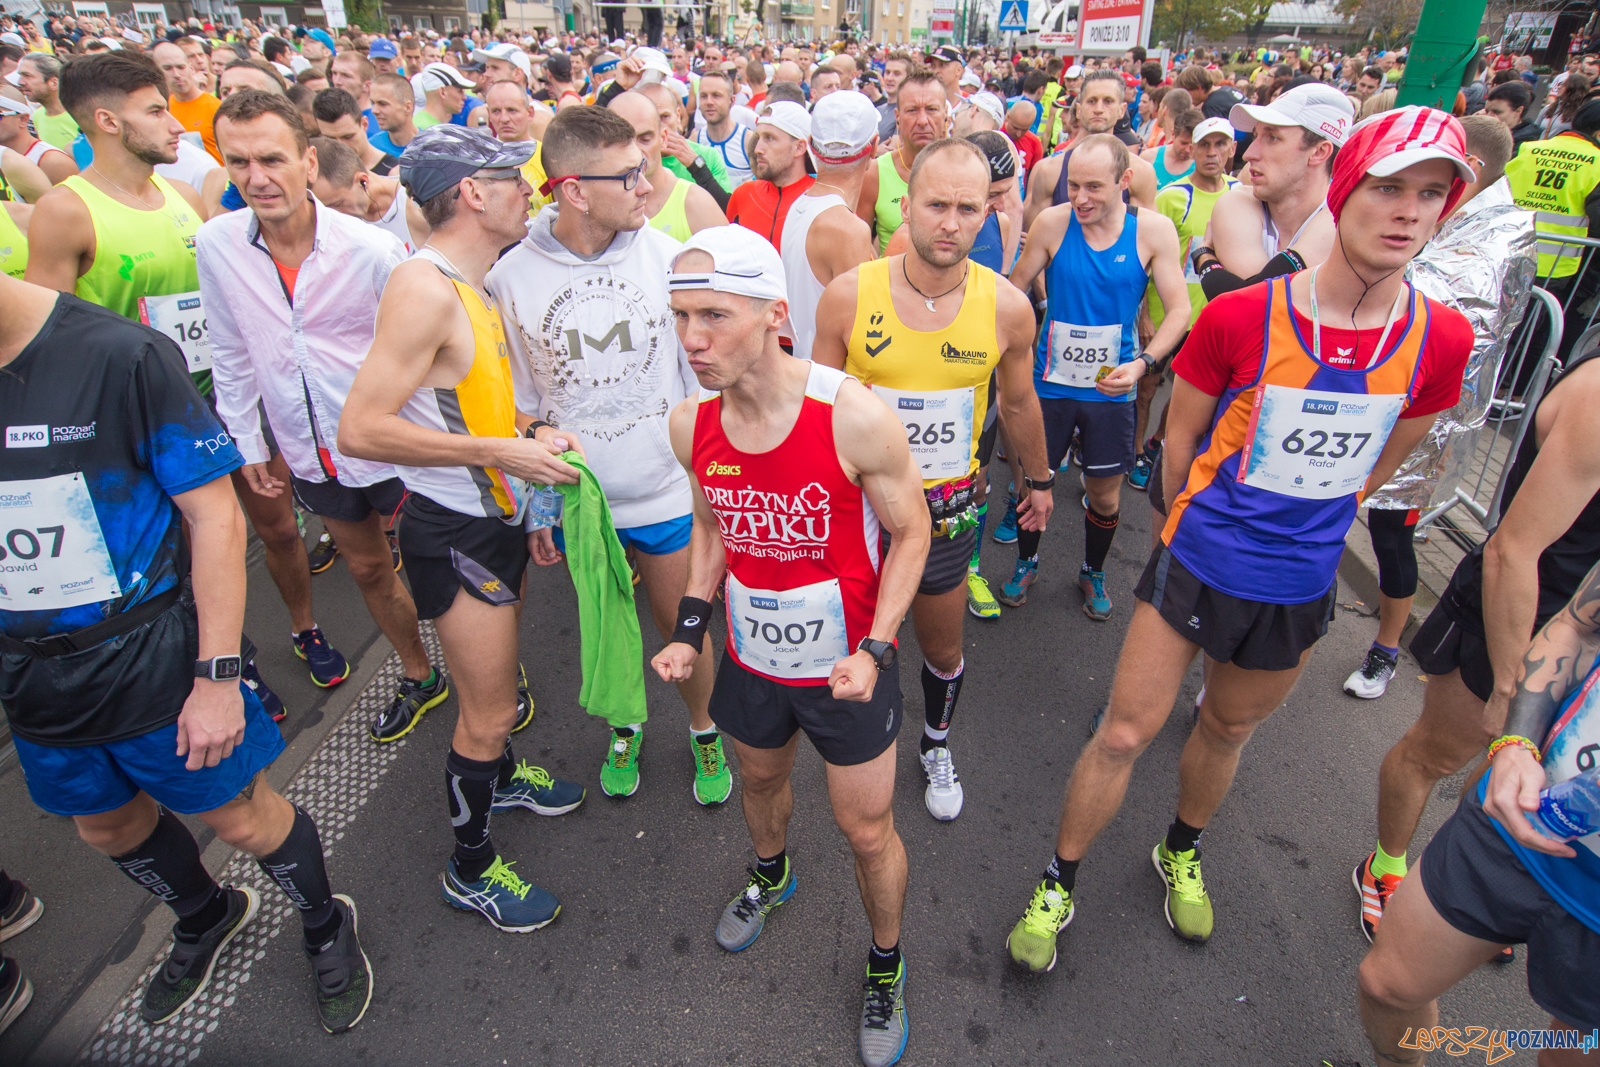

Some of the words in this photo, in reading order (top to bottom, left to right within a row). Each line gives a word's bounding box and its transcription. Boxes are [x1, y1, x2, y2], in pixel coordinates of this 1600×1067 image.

[1090, 22, 1115, 42] PONIŻEJ
[1116, 25, 1130, 42] 3:10
[1321, 123, 1341, 138] ORLEN
[1531, 148, 1595, 164] OCHRONA
[1535, 158, 1582, 172] VICTORY
[1534, 169, 1568, 190] 126
[1514, 199, 1569, 214] FORMACYJNA
[134, 251, 155, 262] MTB
[1113, 254, 1126, 262] NB
[187, 299, 199, 307] PKO
[961, 350, 987, 358] KAUNO
[1063, 346, 1109, 363] 6283
[1317, 403, 1335, 411] PKO
[9, 432, 21, 442] 18.
[22, 431, 45, 441] PKO
[53, 430, 96, 442] maraton
[1281, 428, 1373, 459] 6237
[908, 445, 938, 453] intaras
[1308, 458, 1336, 468] Rafał
[703, 484, 808, 515] DRUŻYNA
[712, 508, 832, 543] SZPIKU
[723, 540, 824, 563] www.darszpiku.pl
[744, 616, 824, 645] 7007
